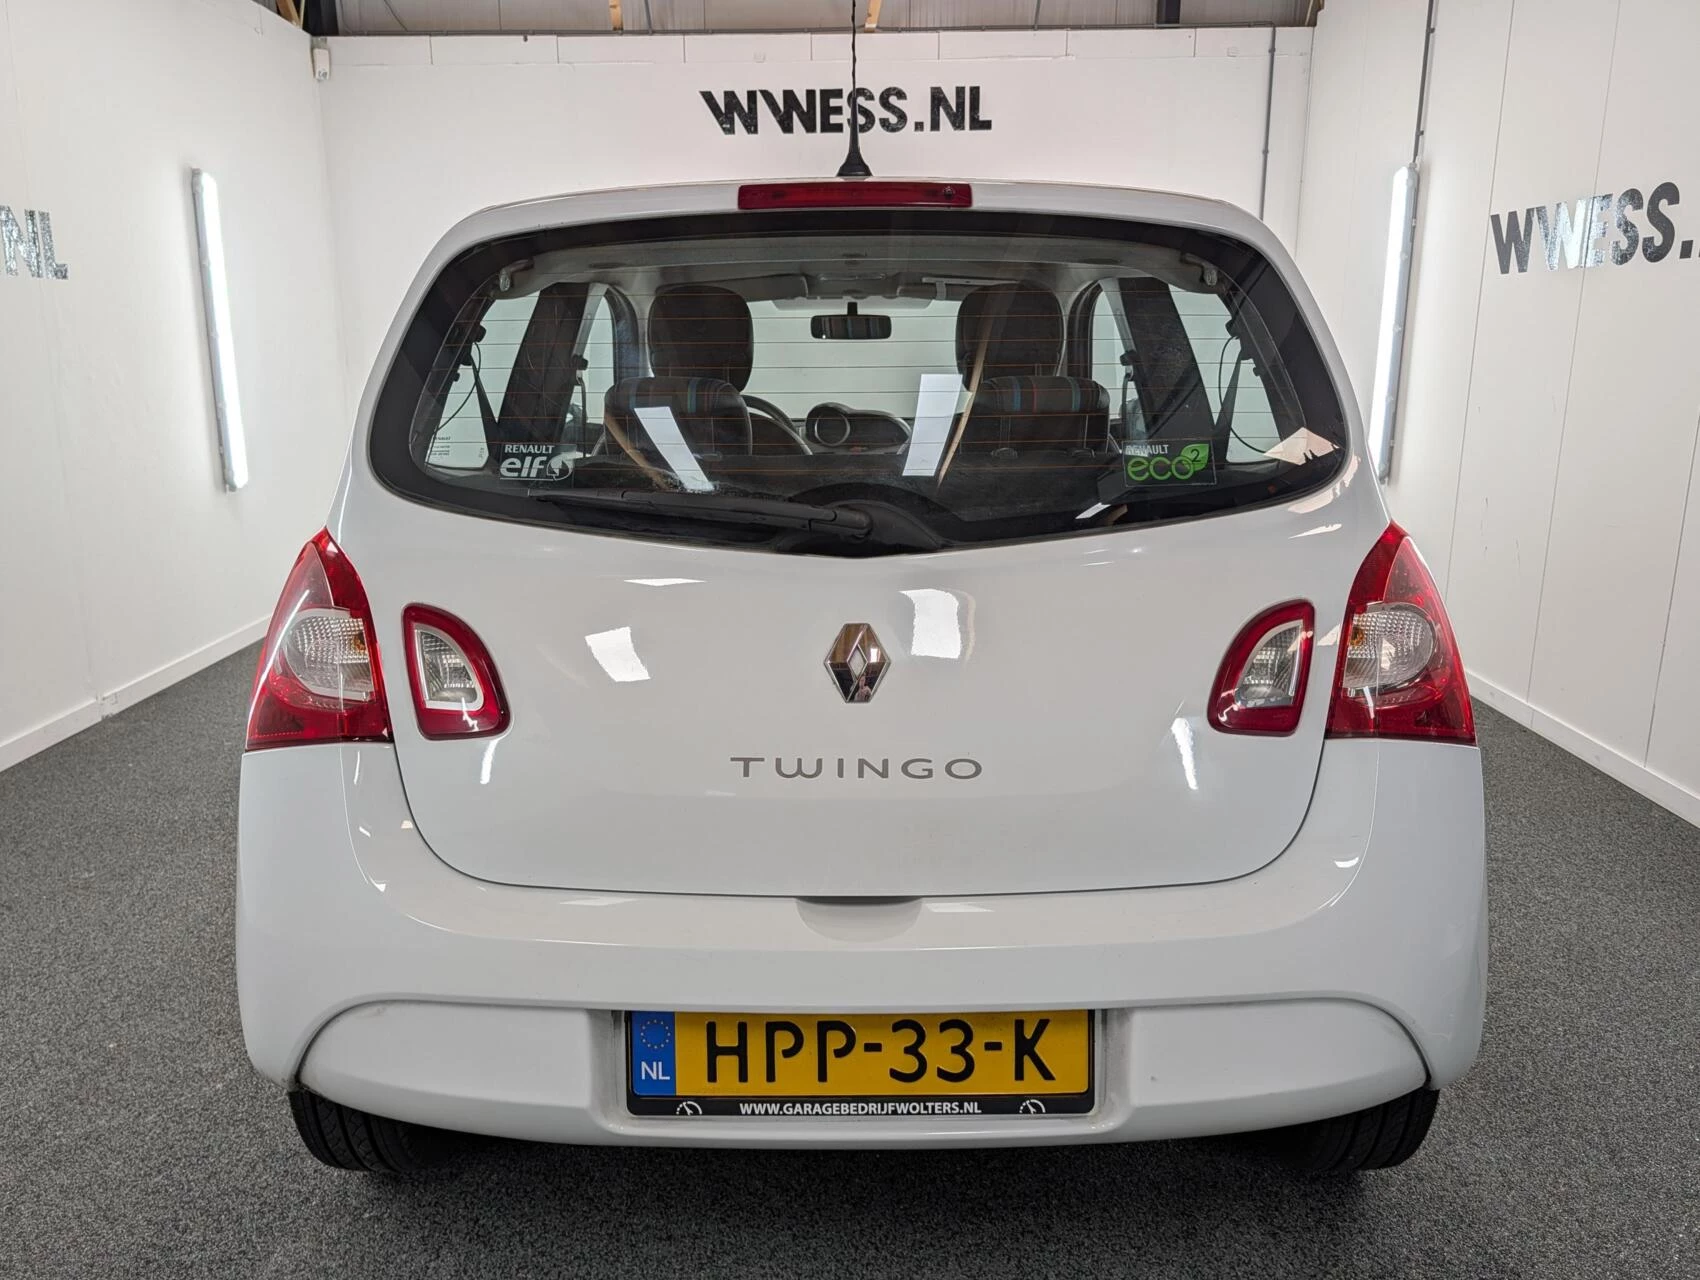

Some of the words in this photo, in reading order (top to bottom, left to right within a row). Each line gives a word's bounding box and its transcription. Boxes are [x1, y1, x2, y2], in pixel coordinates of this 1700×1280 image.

[699, 86, 992, 135] WWESS.NL
[1490, 181, 1700, 275] WWESS.
[504, 444, 556, 454] RENAULT
[500, 456, 547, 478] elf
[729, 757, 983, 780] TWINGO
[706, 1018, 1057, 1084] HPP-33-K
[641, 1060, 671, 1081] NL
[739, 1101, 982, 1115] WWW.GARAGEBEDRIJFWOLTERS.NL
